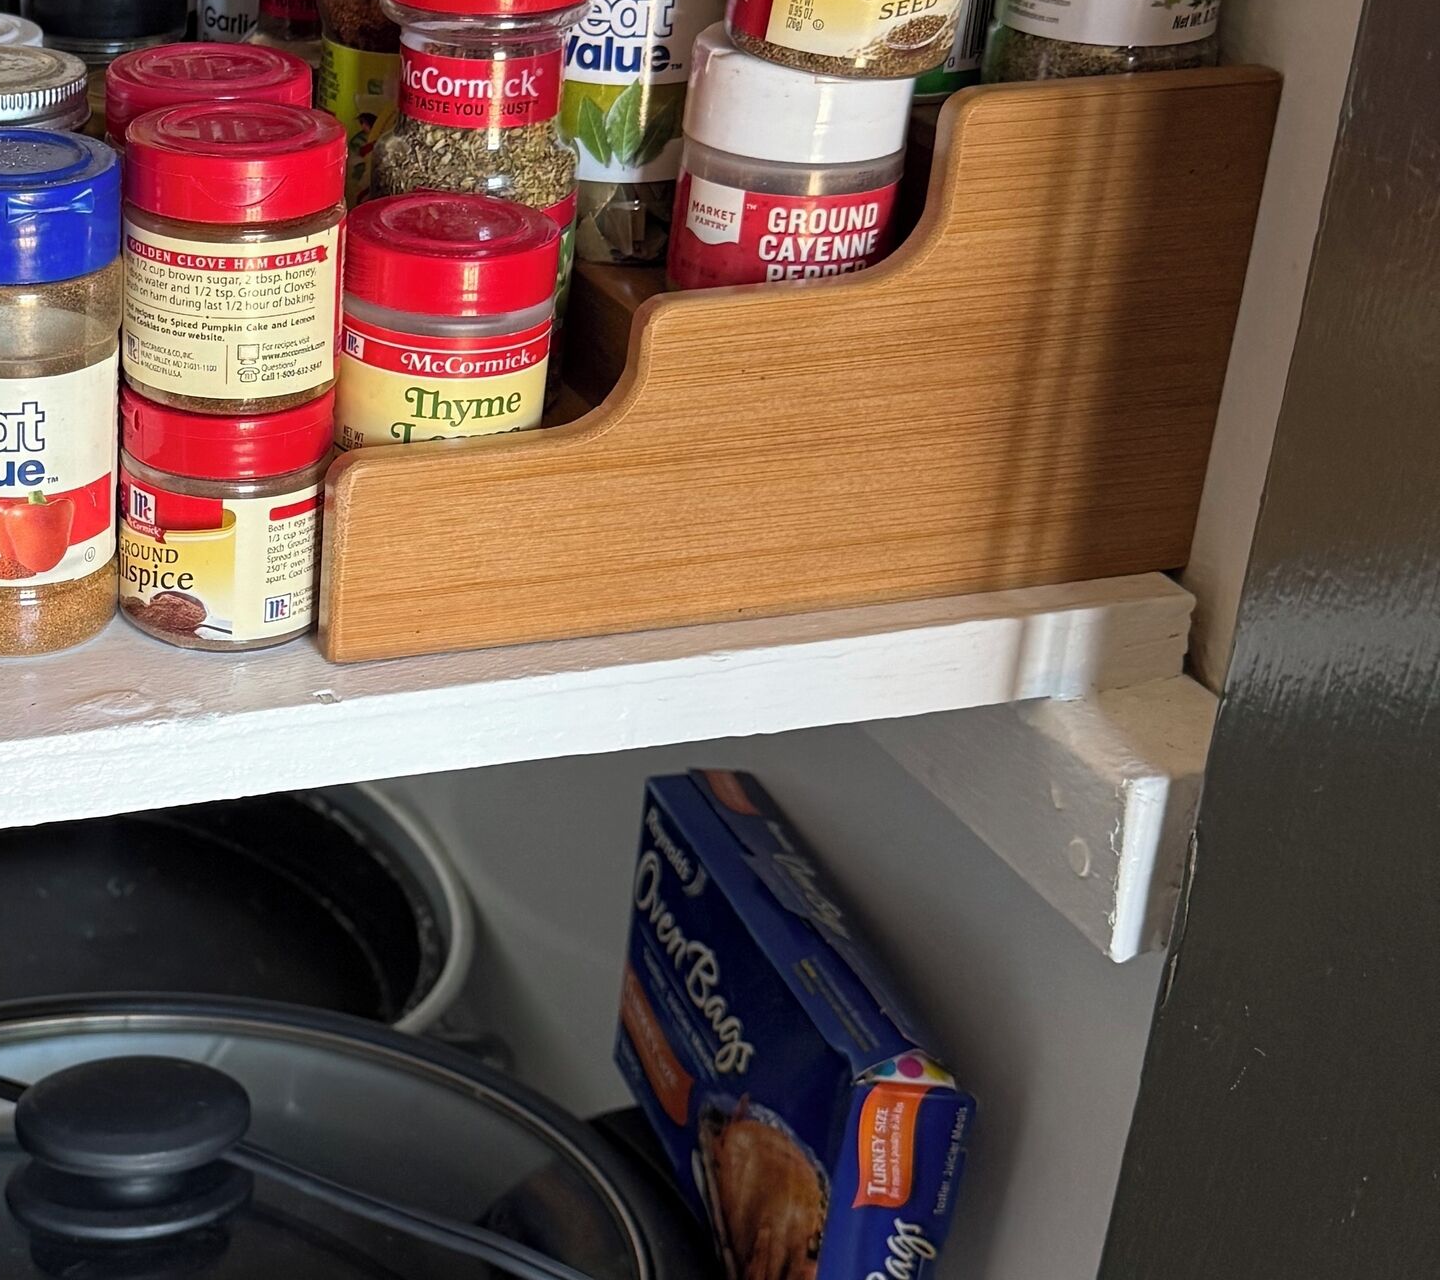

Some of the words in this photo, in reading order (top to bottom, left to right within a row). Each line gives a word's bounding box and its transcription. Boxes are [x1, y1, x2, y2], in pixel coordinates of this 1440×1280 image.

[803, 7, 814, 20] OZ
[401, 57, 539, 98] McCormck
[414, 95, 450, 113] TASTE
[454, 102, 484, 116] YOU
[691, 199, 737, 224] MARKET
[694, 215, 728, 232] PANTRY
[768, 202, 879, 235] GROUND
[130, 239, 171, 263] GOLDEN
[177, 255, 226, 269] CLOVE
[234, 258, 268, 269] HAM
[275, 248, 318, 266] GLAZE
[759, 229, 880, 262] CAYENNE
[168, 267, 203, 283] brown
[207, 275, 242, 287] sugar,
[245, 275, 251, 284] 2
[169, 295, 201, 311] during
[205, 299, 222, 311] last
[227, 300, 242, 311] 1/2
[245, 300, 270, 311] hour
[272, 296, 282, 308] of
[171, 284, 190, 294] and
[195, 286, 212, 297] 1/2
[216, 288, 235, 300] tsp.
[238, 286, 280, 298] Ground
[161, 326, 171, 335] on
[172, 330, 186, 338] our
[188, 331, 225, 342] website.
[171, 318, 198, 330] Spiced
[202, 322, 242, 333] Pumpkin
[247, 323, 268, 332] Cake
[272, 319, 288, 329] and
[401, 349, 530, 375] McCormick
[404, 386, 522, 427] Thyme
[121, 553, 194, 593] llspice
[685, 940, 755, 1074] Bags
[872, 1106, 889, 1135] SIZE
[867, 1136, 888, 1198] TURKEY
